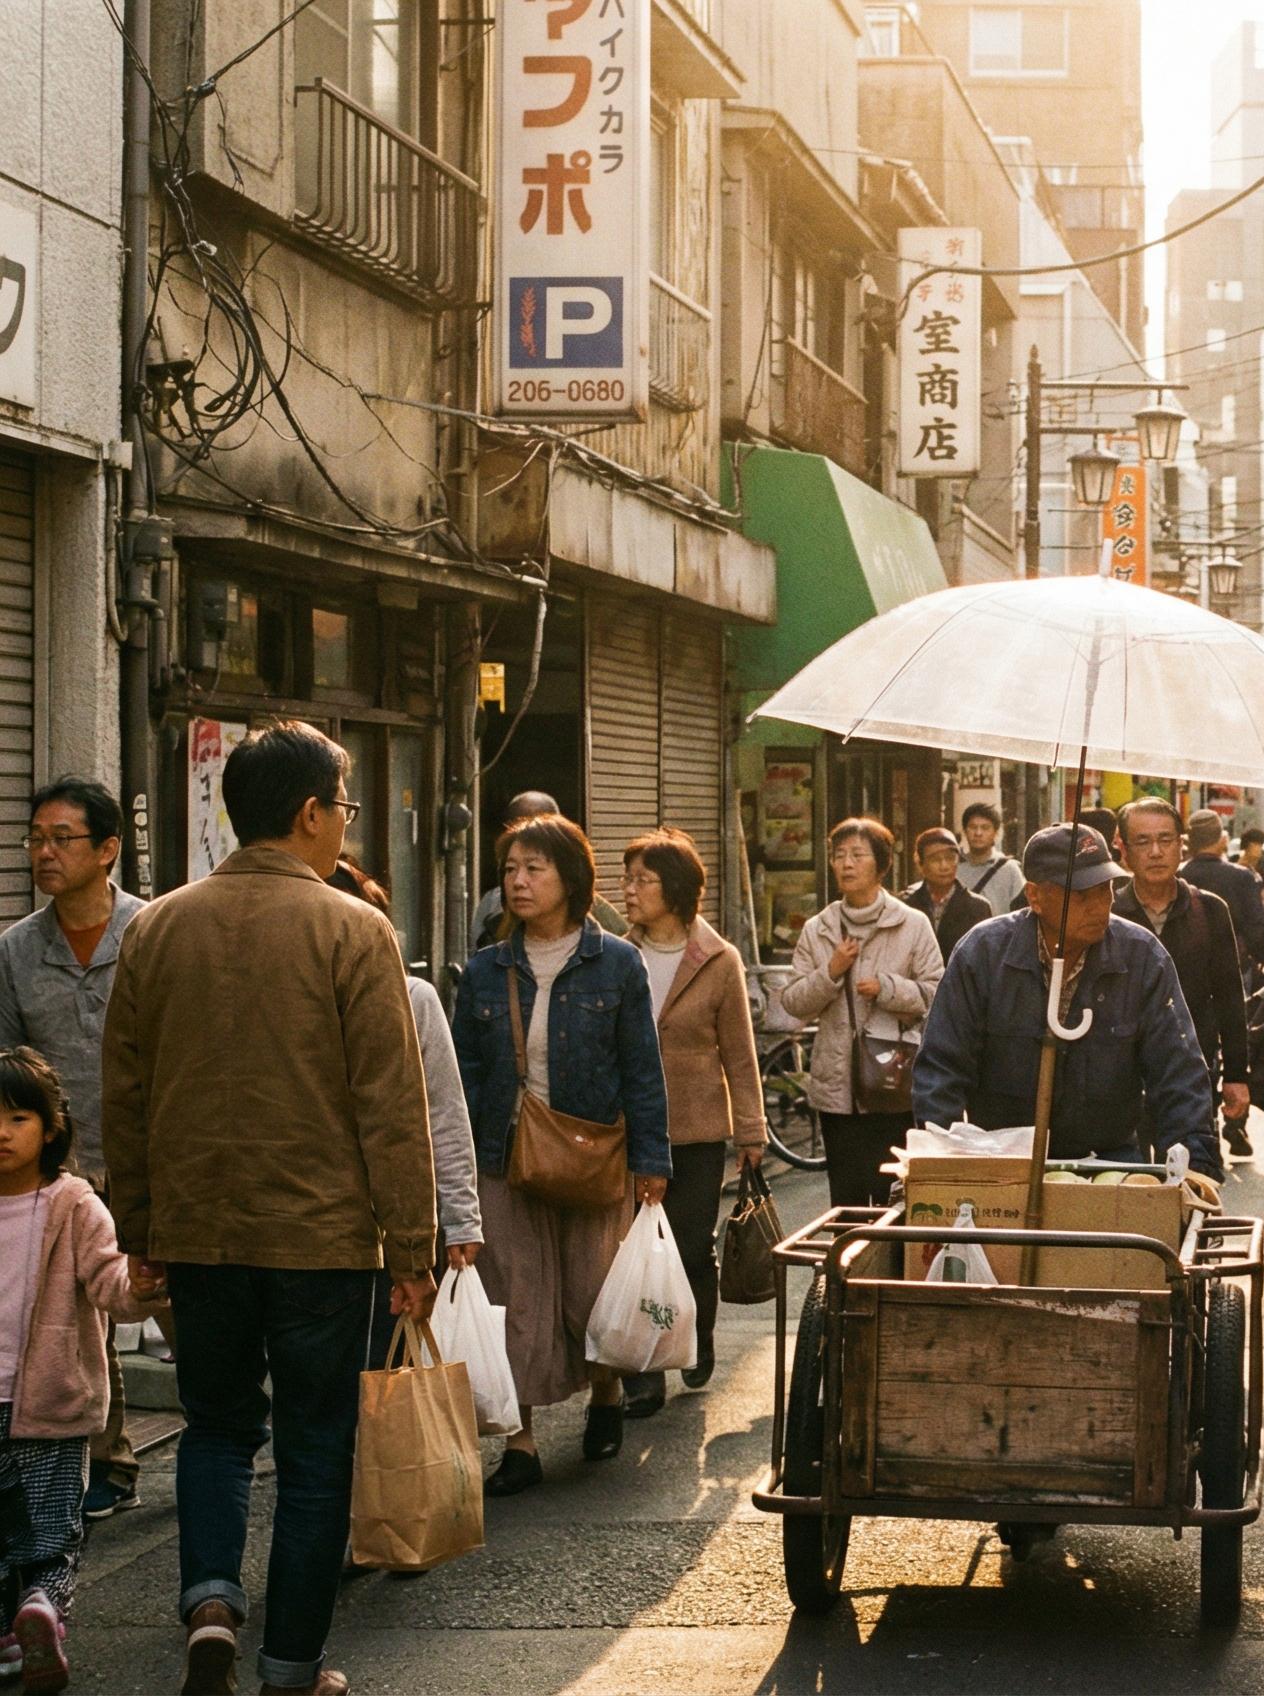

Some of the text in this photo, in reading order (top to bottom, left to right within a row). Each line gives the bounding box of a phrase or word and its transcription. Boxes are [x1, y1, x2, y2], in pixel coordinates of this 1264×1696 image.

[545, 286, 612, 359] P
[912, 310, 961, 461] 室商店
